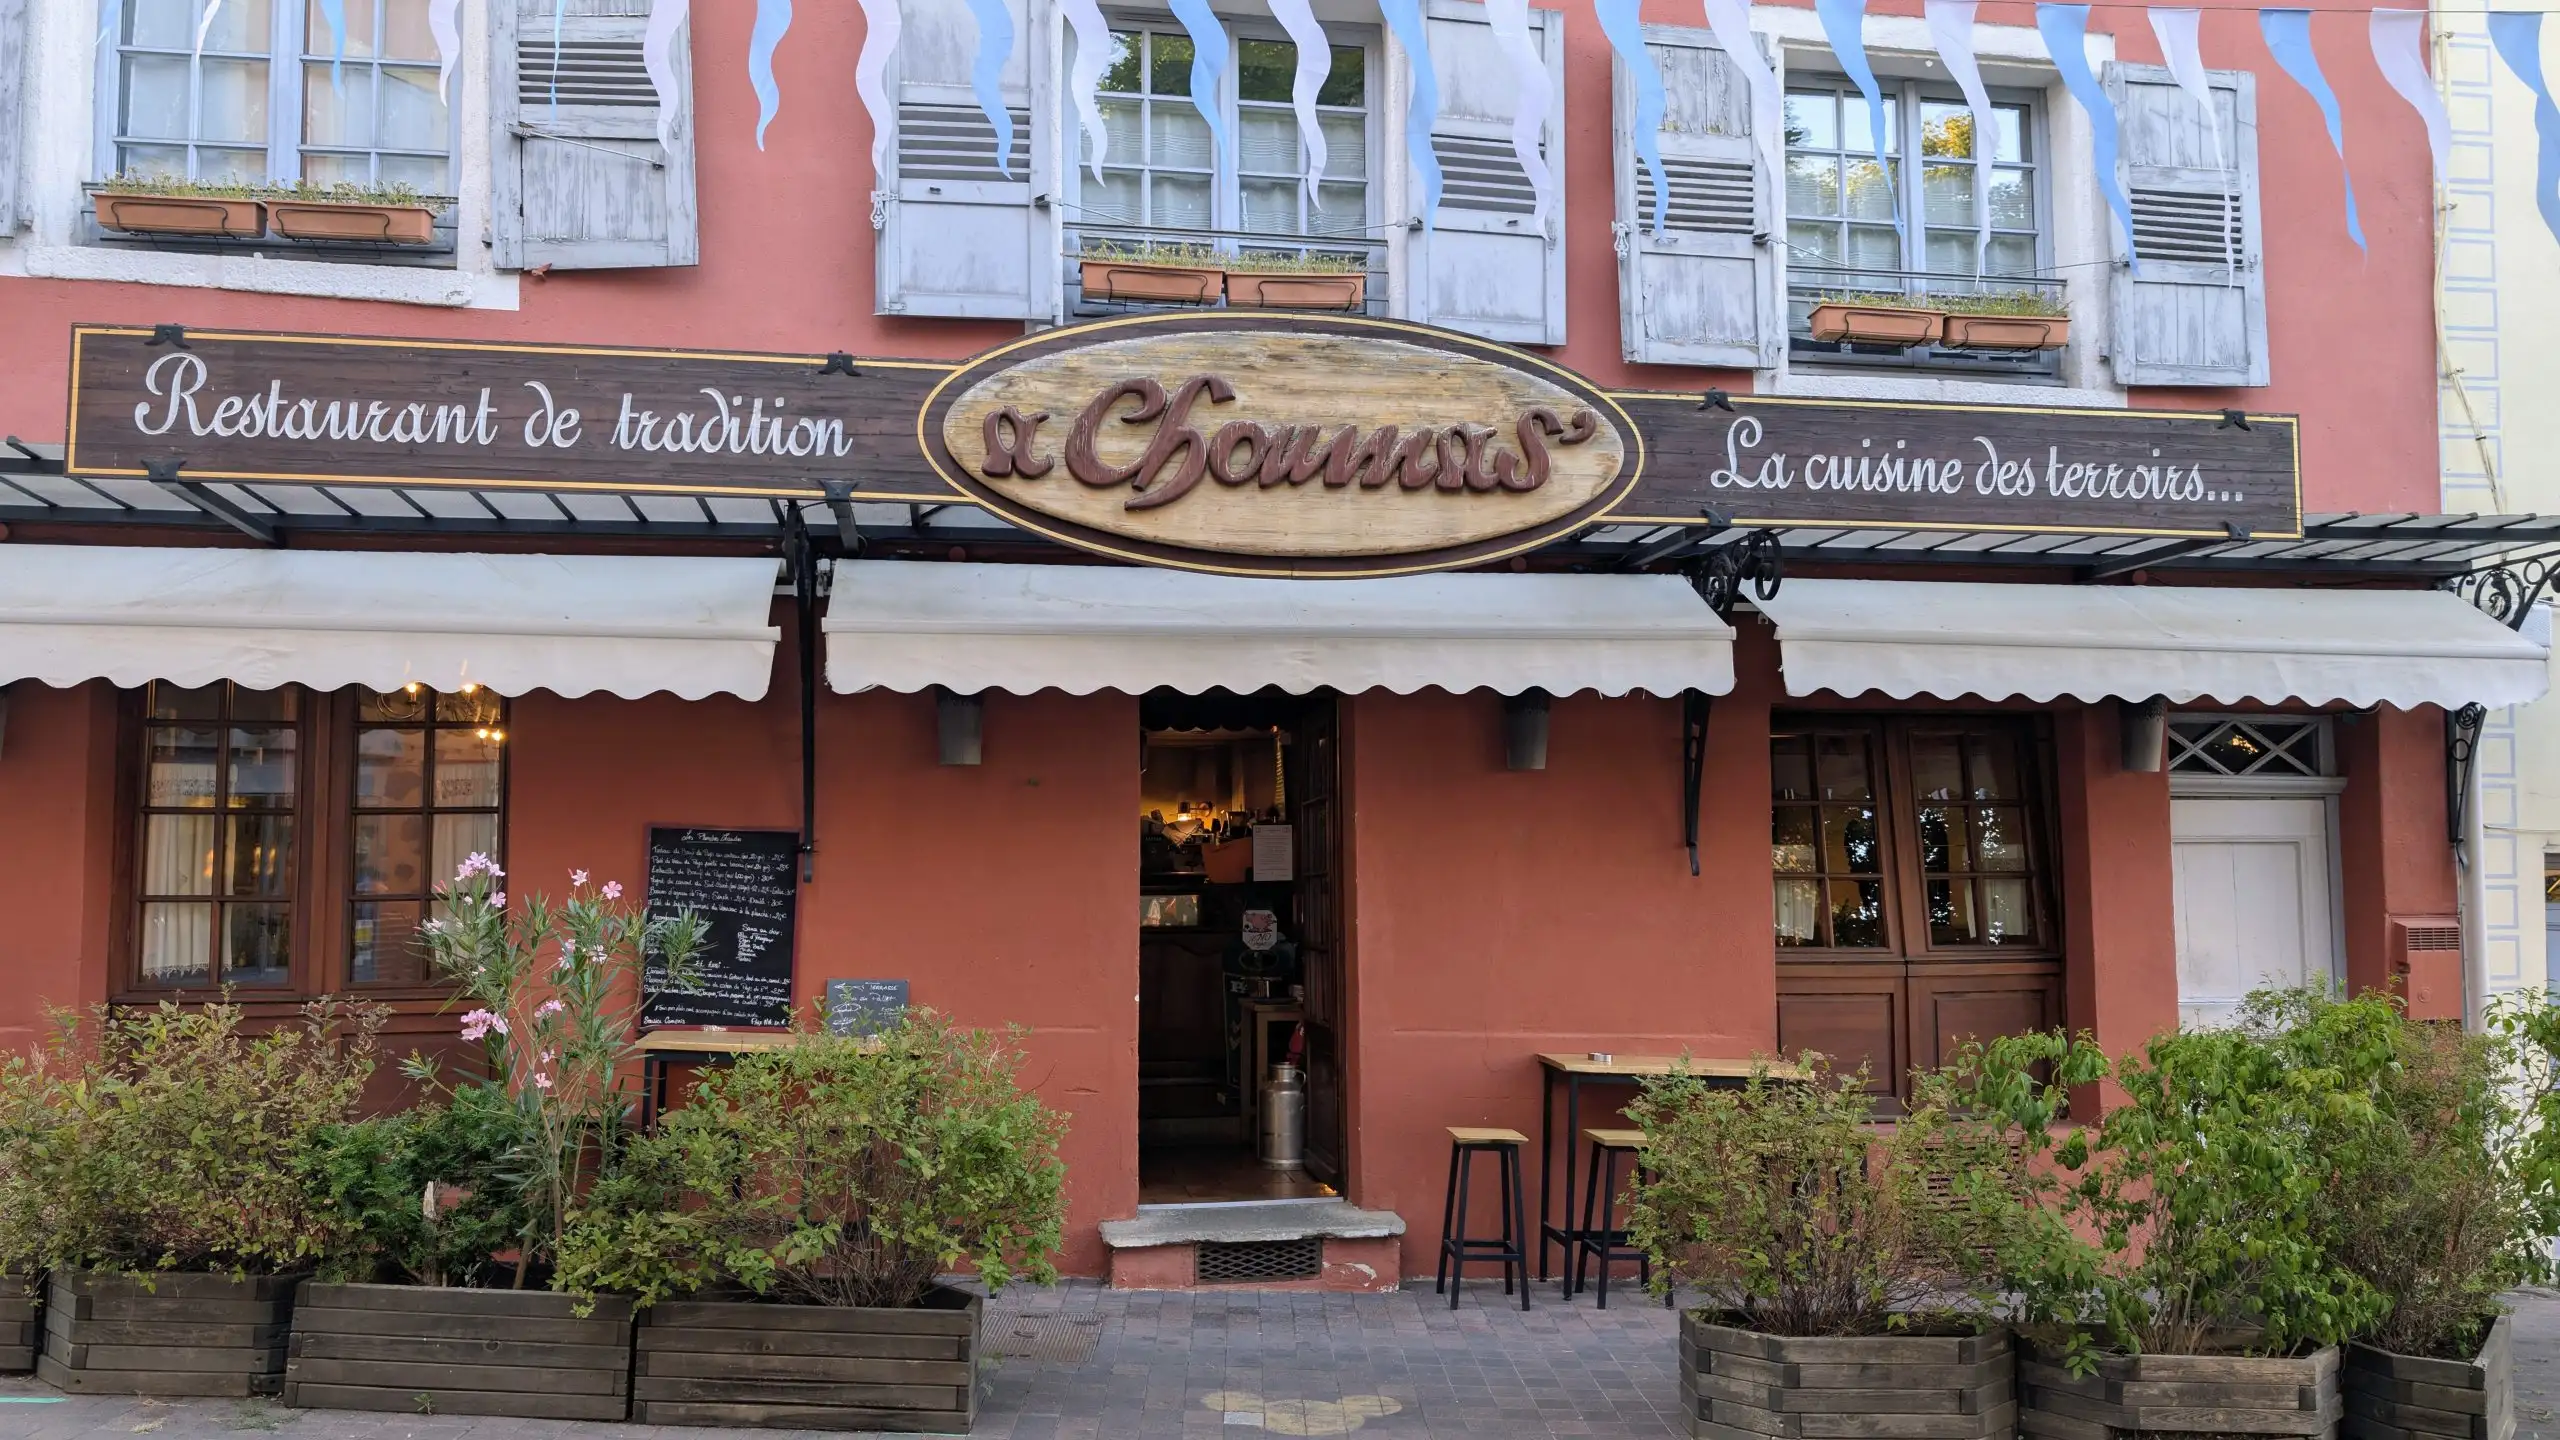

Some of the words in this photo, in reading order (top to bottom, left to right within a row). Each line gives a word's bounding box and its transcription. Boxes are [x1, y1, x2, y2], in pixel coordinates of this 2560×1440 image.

[135, 352, 497, 447] Restaurant
[524, 381, 583, 449] de
[610, 387, 853, 457] tradition
[1710, 415, 1795, 490] La
[1804, 438, 1964, 495] cuisine
[1973, 436, 2037, 497] des
[2046, 445, 2244, 503] terroirs...
